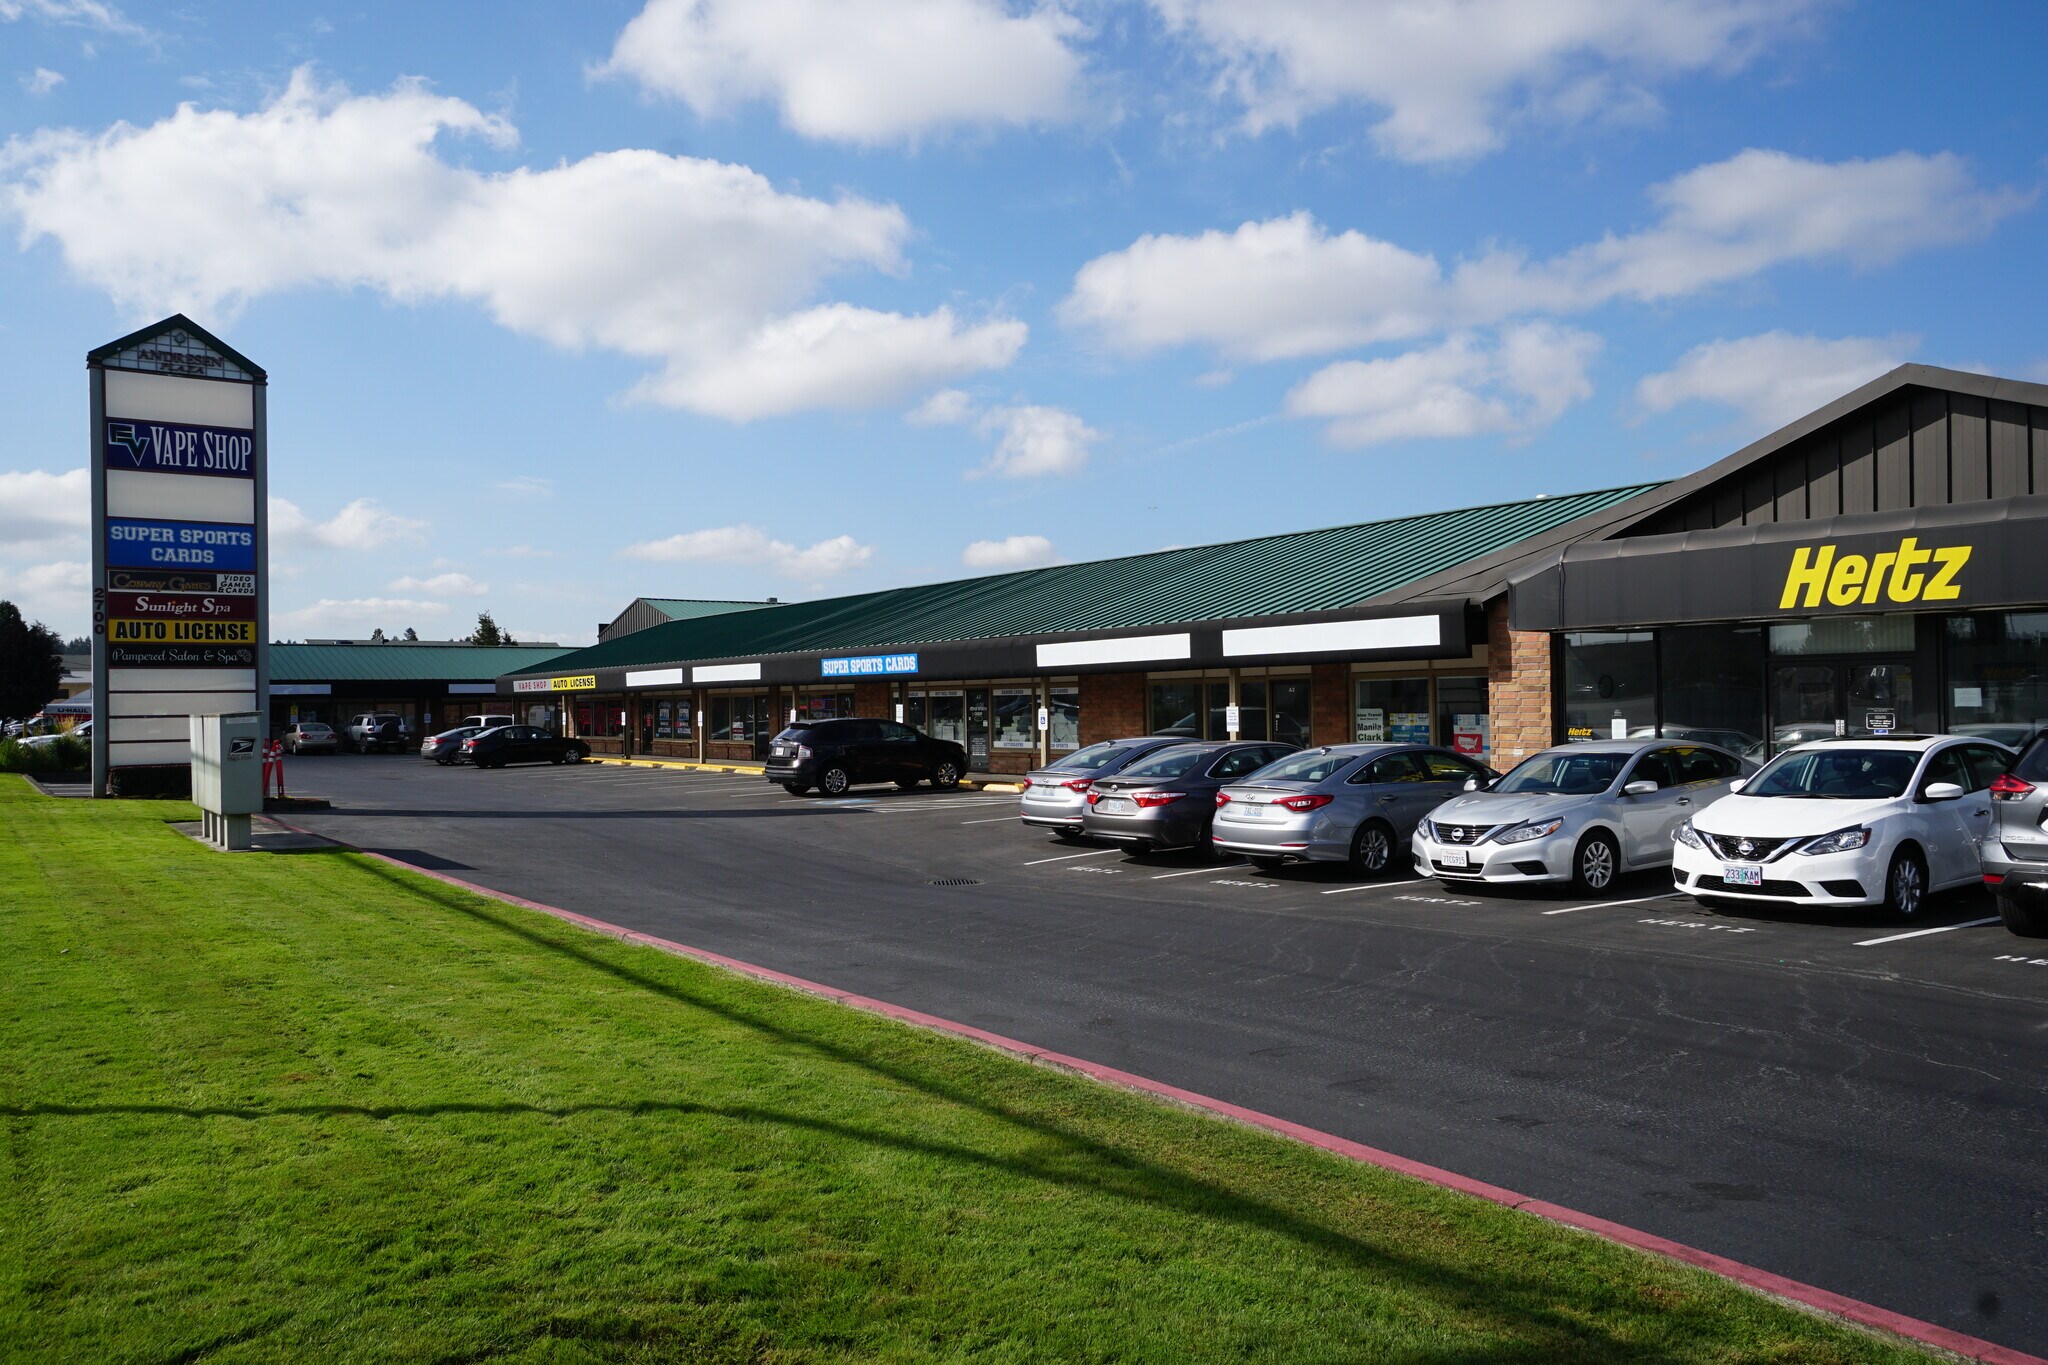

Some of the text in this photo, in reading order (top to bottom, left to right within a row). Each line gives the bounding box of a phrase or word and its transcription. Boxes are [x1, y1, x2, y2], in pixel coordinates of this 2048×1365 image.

[138, 349, 224, 368] ANDRESEN
[159, 362, 205, 375] PLAZA
[150, 426, 198, 467] VAPE
[202, 431, 252, 471] SHOP
[110, 525, 252, 546] SUPER SPORTS
[151, 547, 215, 564] CARDS
[223, 574, 251, 582] VIDEO
[1779, 537, 1972, 609] Hertz
[135, 596, 231, 615] Sunlight Spa
[115, 621, 249, 640] AUTO LICENSE
[112, 648, 238, 664] Pampered Salon & Spa
[823, 656, 916, 674] SUPER SPORTS CARDS
[518, 680, 547, 690] VAPE SHOP
[553, 677, 594, 688] AUTO LICENSE
[1357, 723, 1382, 731] Manila
[1568, 727, 1592, 736] Hertz
[1358, 733, 1382, 741] Clark
[1725, 868, 1760, 881] 233 KAM
[1393, 895, 1483, 906] HERTZ
[1636, 918, 1756, 933] HERTZ
